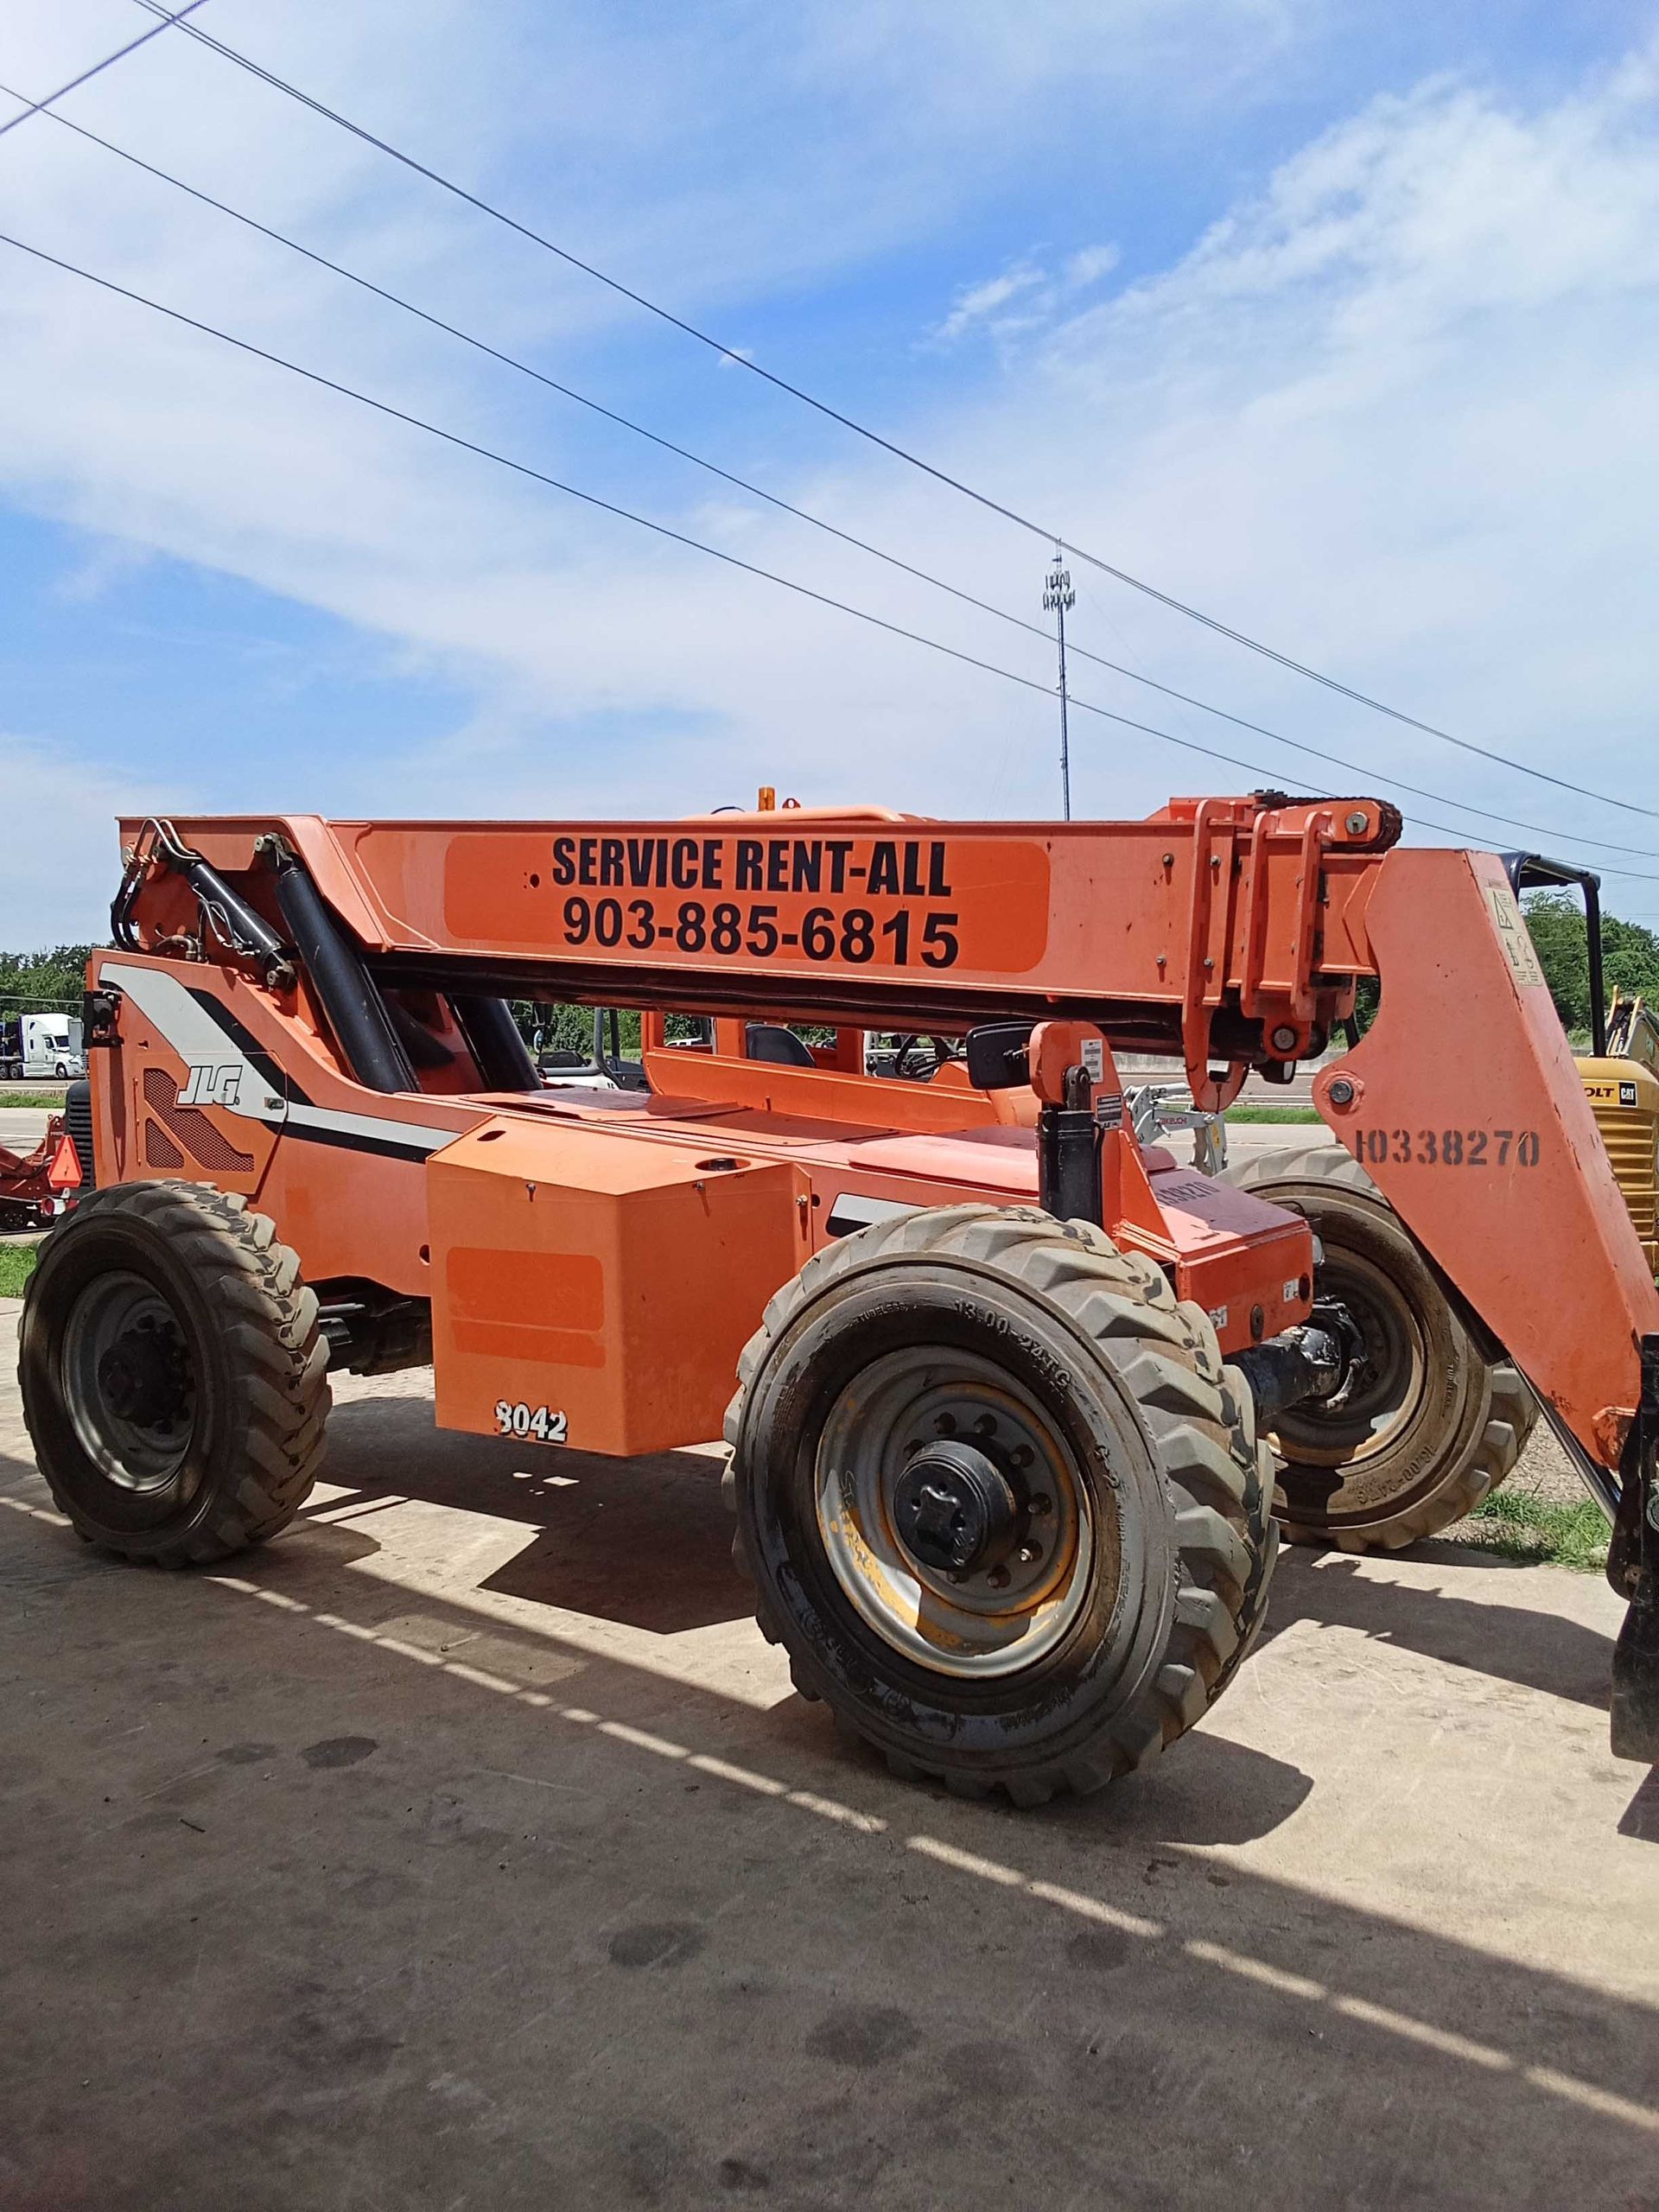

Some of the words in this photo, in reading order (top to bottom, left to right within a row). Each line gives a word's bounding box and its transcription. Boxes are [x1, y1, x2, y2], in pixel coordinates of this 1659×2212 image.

[552, 837, 723, 890] SERVICE
[735, 839, 952, 897] RENT-ALL
[563, 896, 959, 969] 903-885-6815
[176, 1065, 243, 1106] JLG
[1620, 1087, 1635, 1100] CAT
[1356, 1128, 1539, 1166] 10338270
